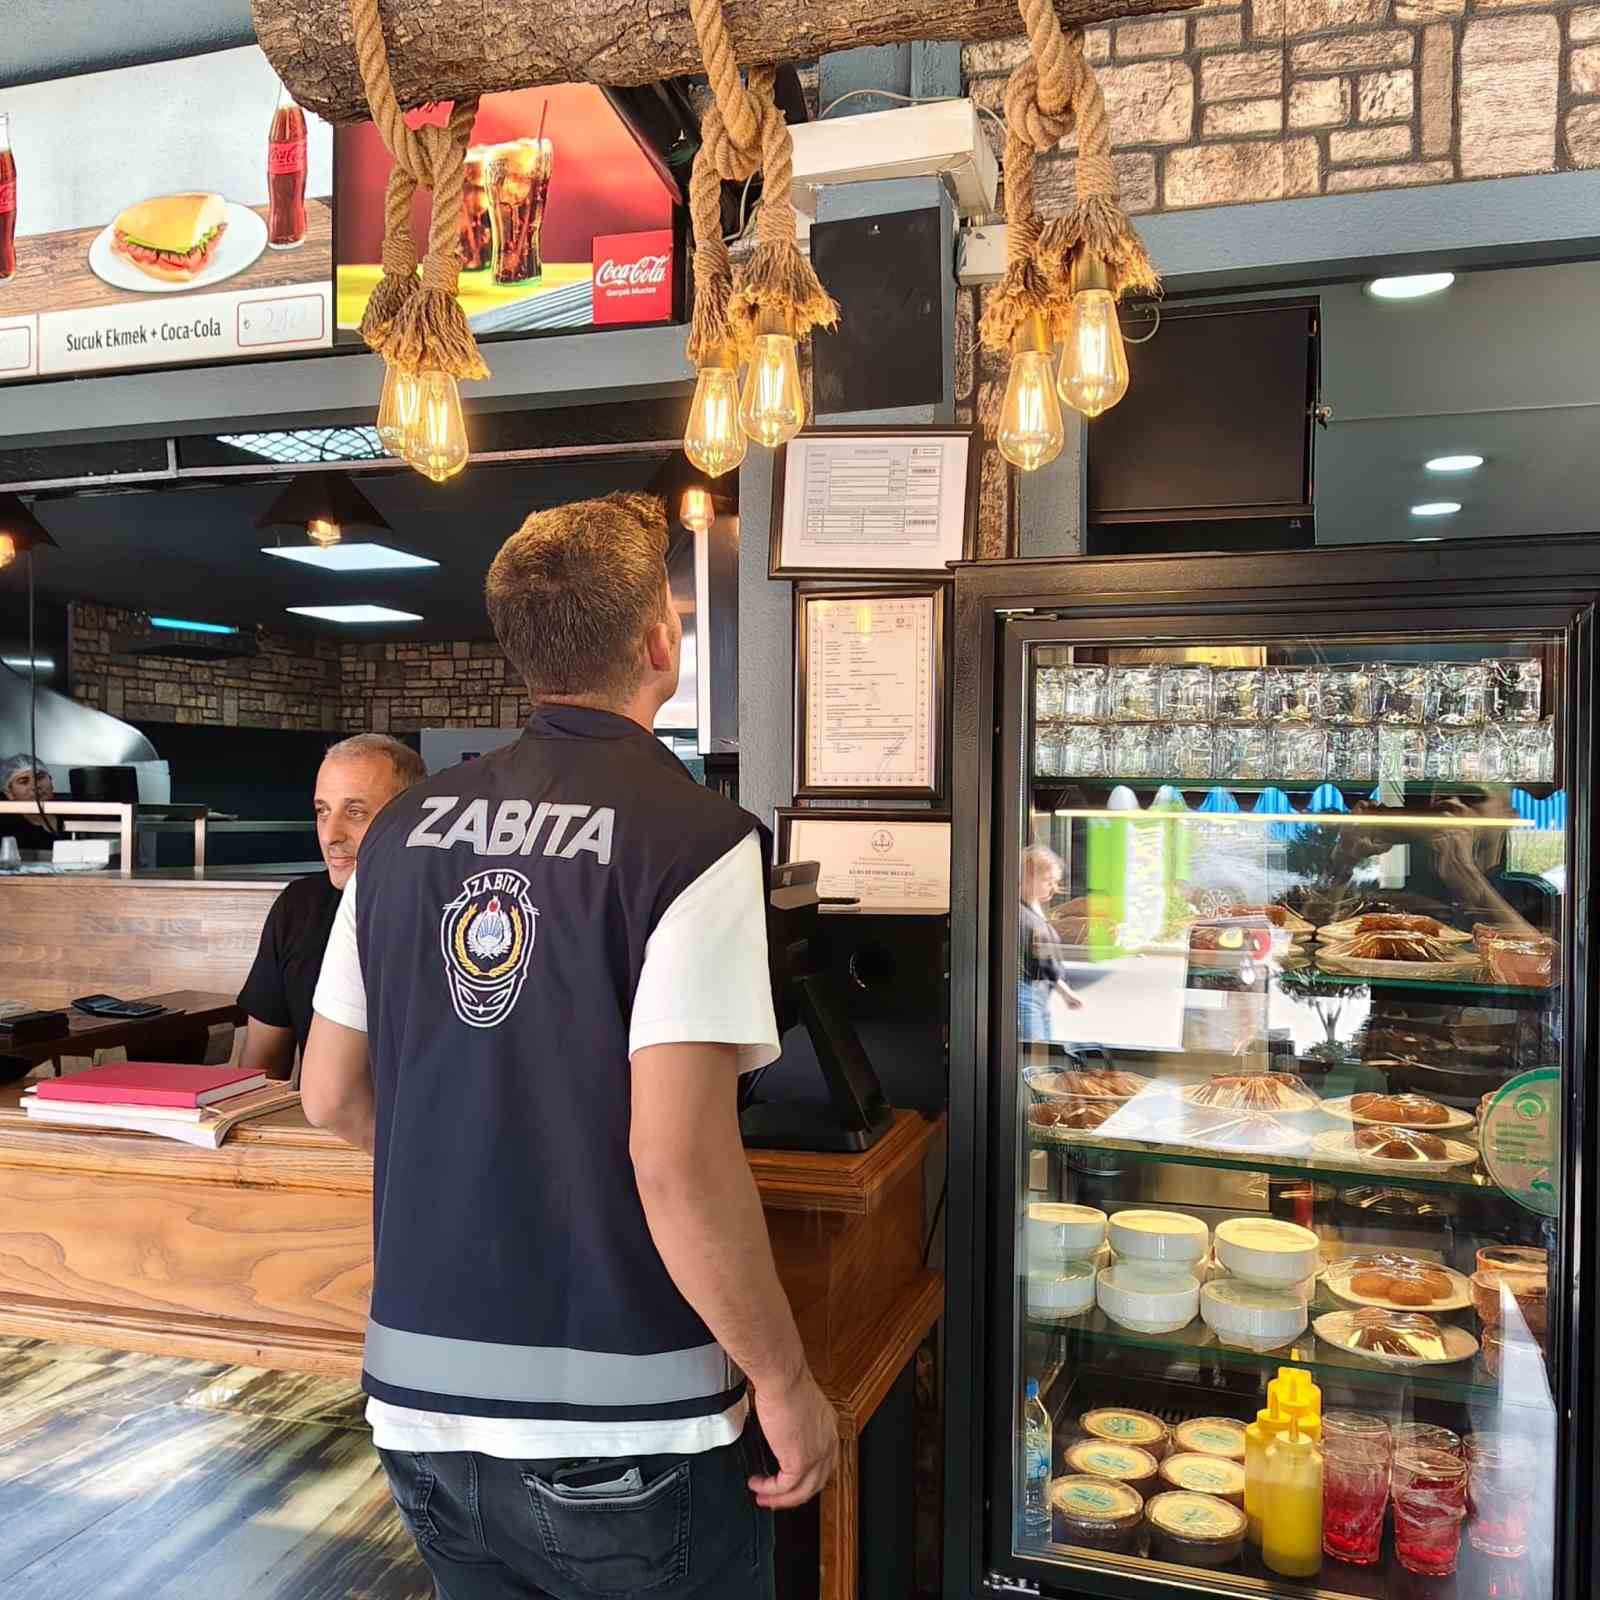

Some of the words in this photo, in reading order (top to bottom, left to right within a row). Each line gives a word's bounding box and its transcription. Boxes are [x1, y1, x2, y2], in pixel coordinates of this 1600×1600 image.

[66, 332, 103, 351] Sucuk
[105, 325, 148, 347] Ekmek
[150, 330, 157, 338] +
[160, 317, 221, 341] Coca-Cola
[406, 797, 615, 865] ZABITA
[471, 873, 521, 898] ZABITA
